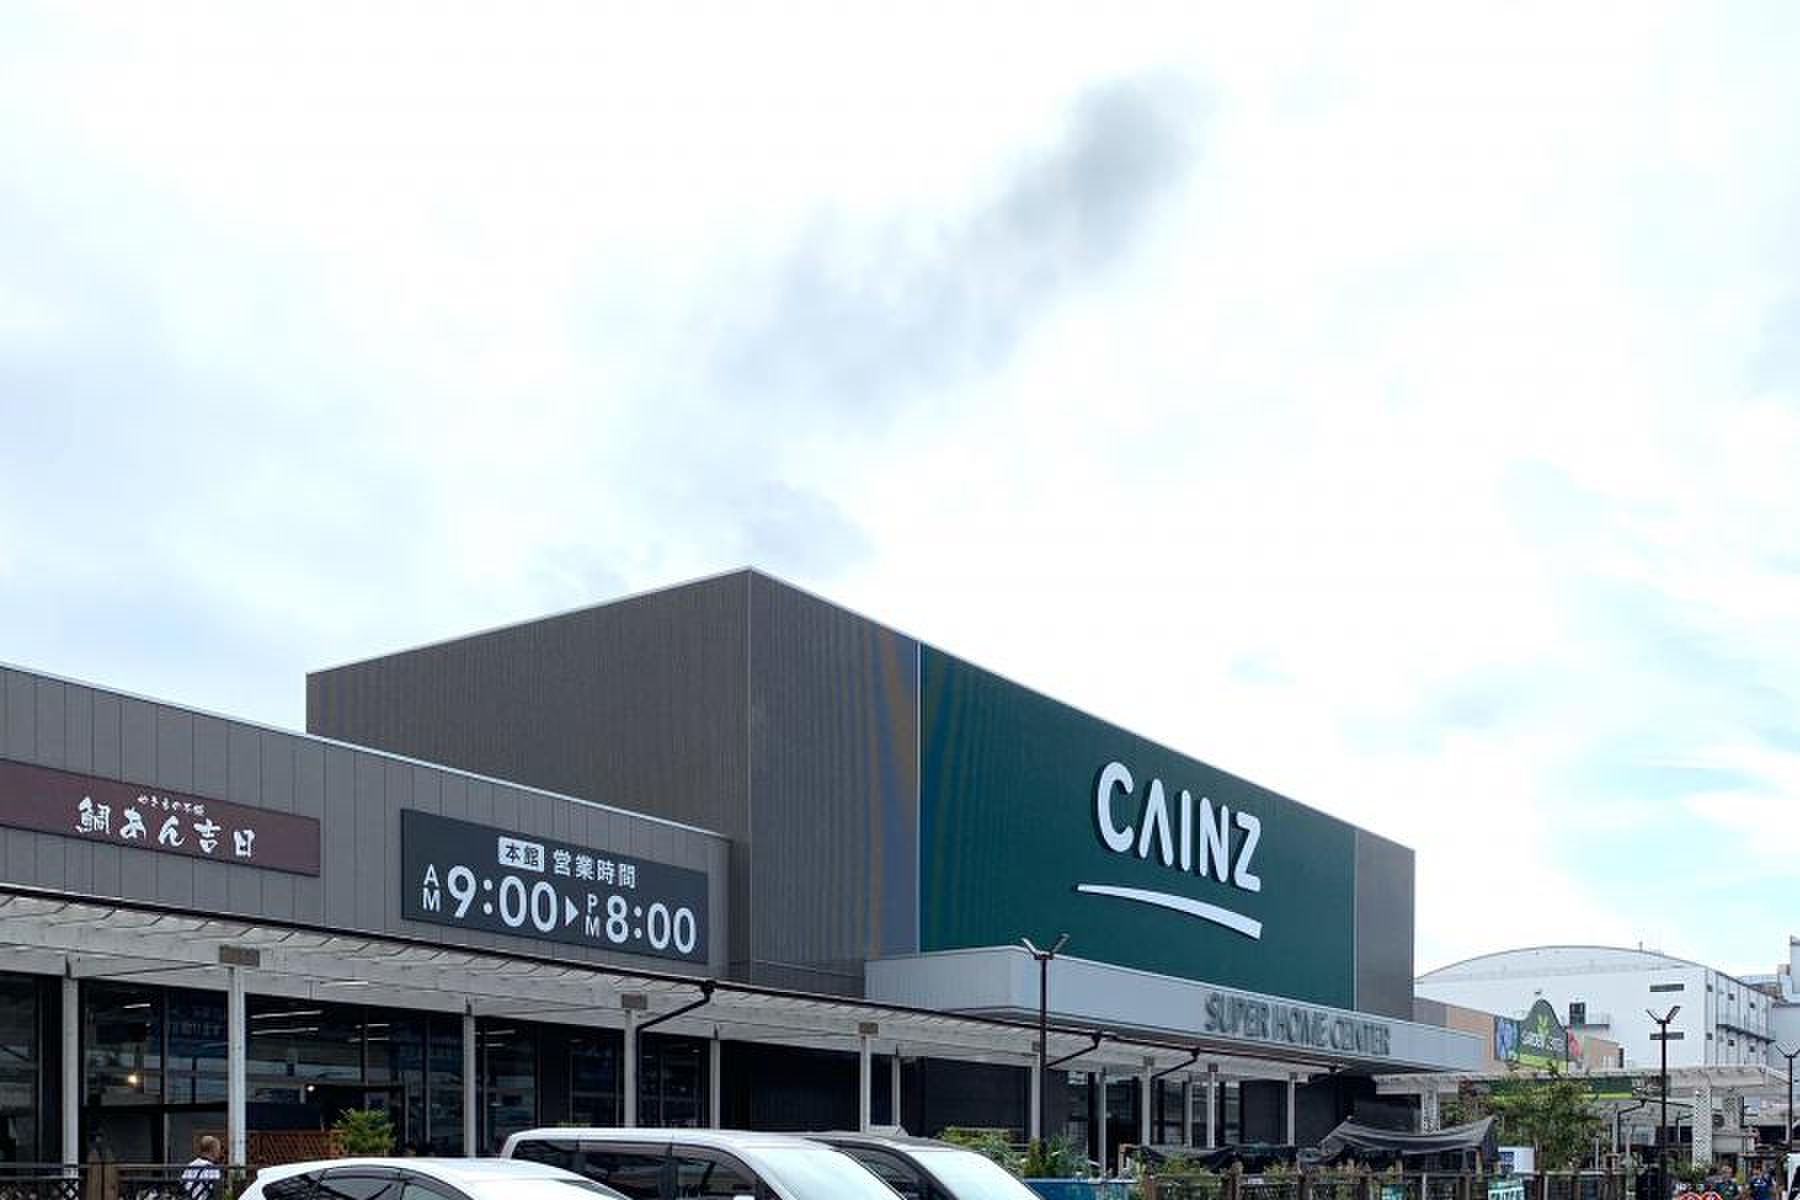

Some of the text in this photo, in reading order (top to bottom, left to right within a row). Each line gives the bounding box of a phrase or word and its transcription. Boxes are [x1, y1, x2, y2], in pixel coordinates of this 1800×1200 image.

[76, 796, 255, 857] 鯛あん吉日
[1098, 762, 1261, 891] CAINZ
[503, 841, 636, 889] 本館 営業時間
[447, 865, 557, 932] 9:00
[606, 895, 697, 954] 8:00
[1205, 991, 1390, 1056] SUPER HOME CENTER
